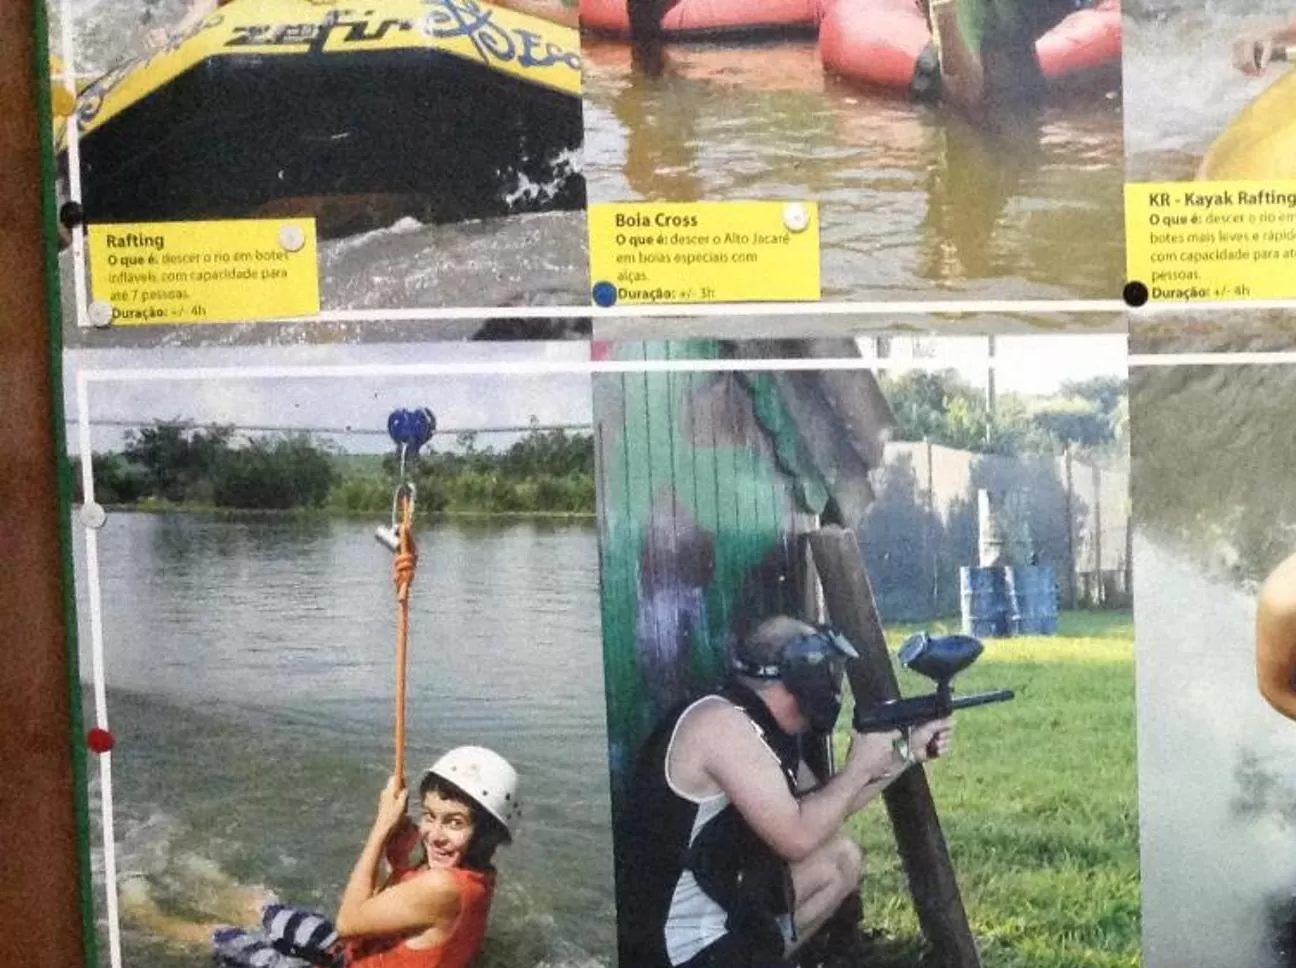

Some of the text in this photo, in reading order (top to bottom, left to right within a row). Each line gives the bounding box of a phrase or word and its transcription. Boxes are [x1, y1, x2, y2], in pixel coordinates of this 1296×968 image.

[1150, 191, 1296, 208] KR Kayak Rafting
[616, 213, 698, 227] Boia Cross
[1150, 214, 1187, 228] O que
[106, 234, 164, 251] Rafting
[616, 232, 790, 247] O que descer o Alto Jacaré
[1188, 230, 1249, 243] mais leves
[108, 255, 144, 268] O que
[674, 252, 757, 265] especiais com
[1151, 251, 1177, 262] com
[1180, 249, 1249, 261] capacidade
[1254, 249, 1279, 261] para
[262, 269, 287, 280] para
[618, 288, 676, 300] Duração:
[1153, 287, 1209, 301] Duração:
[112, 307, 167, 320] Duração:
